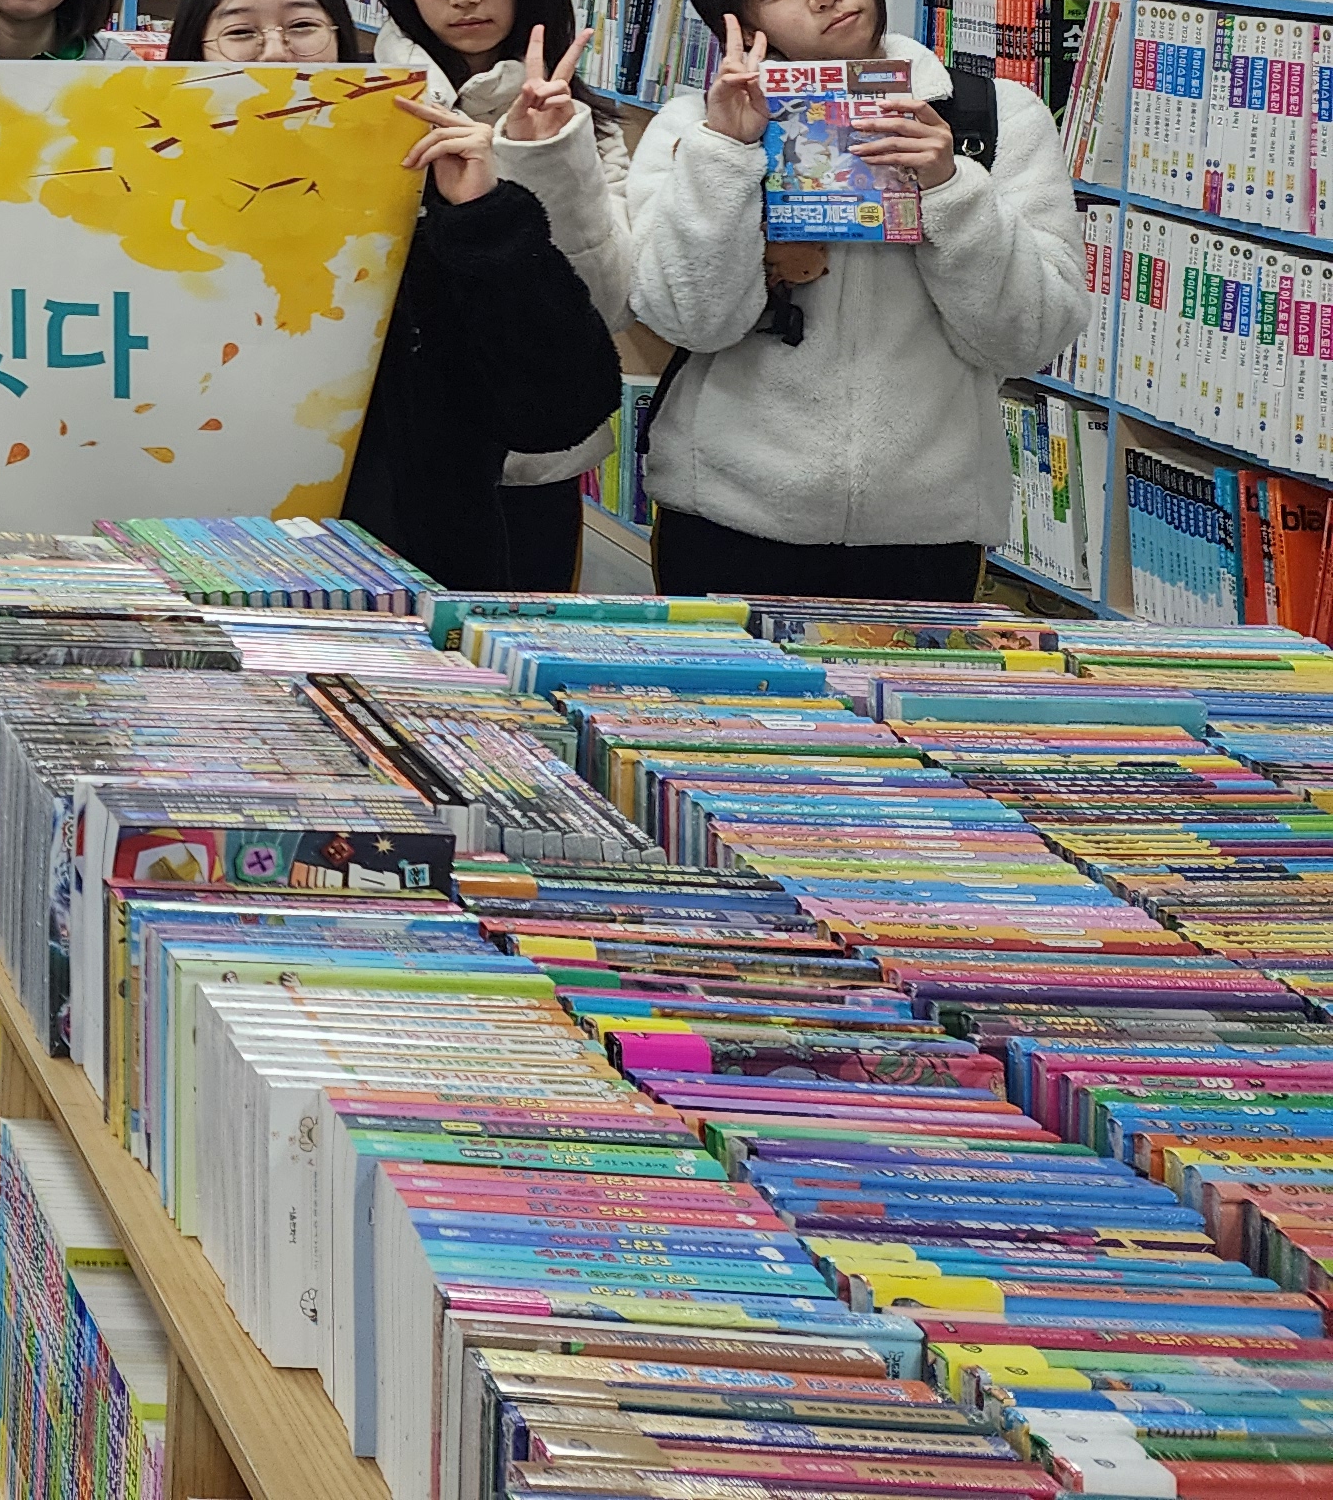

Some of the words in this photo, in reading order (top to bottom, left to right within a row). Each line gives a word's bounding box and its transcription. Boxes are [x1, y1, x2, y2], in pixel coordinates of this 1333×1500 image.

[765, 66, 844, 93] 포켓몬
[1134, 42, 1144, 88] 자이스토리
[1146, 43, 1157, 90] 자이스토리
[1165, 46, 1174, 93] 자이스토리
[1177, 48, 1188, 95] 자이스토리
[1190, 49, 1202, 98] 자이스토리
[1234, 58, 1246, 107] 자이스토리
[1252, 58, 1264, 108] 자이스토리
[1270, 62, 1282, 113] 자이스토리
[1289, 64, 1302, 116] 자이스토리
[1321, 69, 1332, 120] 자이스토리
[1138, 255, 1149, 302] 자이스토리
[1153, 260, 1163, 308] 자이스토리
[1184, 269, 1196, 318] 자이스토리
[1207, 276, 1220, 324] 자이스토리
[1223, 281, 1235, 331] 자이스토리
[1240, 285, 1250, 335] 자이스토리
[1263, 293, 1274, 343] 자이스토리
[1278, 278, 1291, 334] 자이스토리
[1298, 303, 1310, 355] 자이스토리
[1321, 306, 1331, 358] 자이스토리
